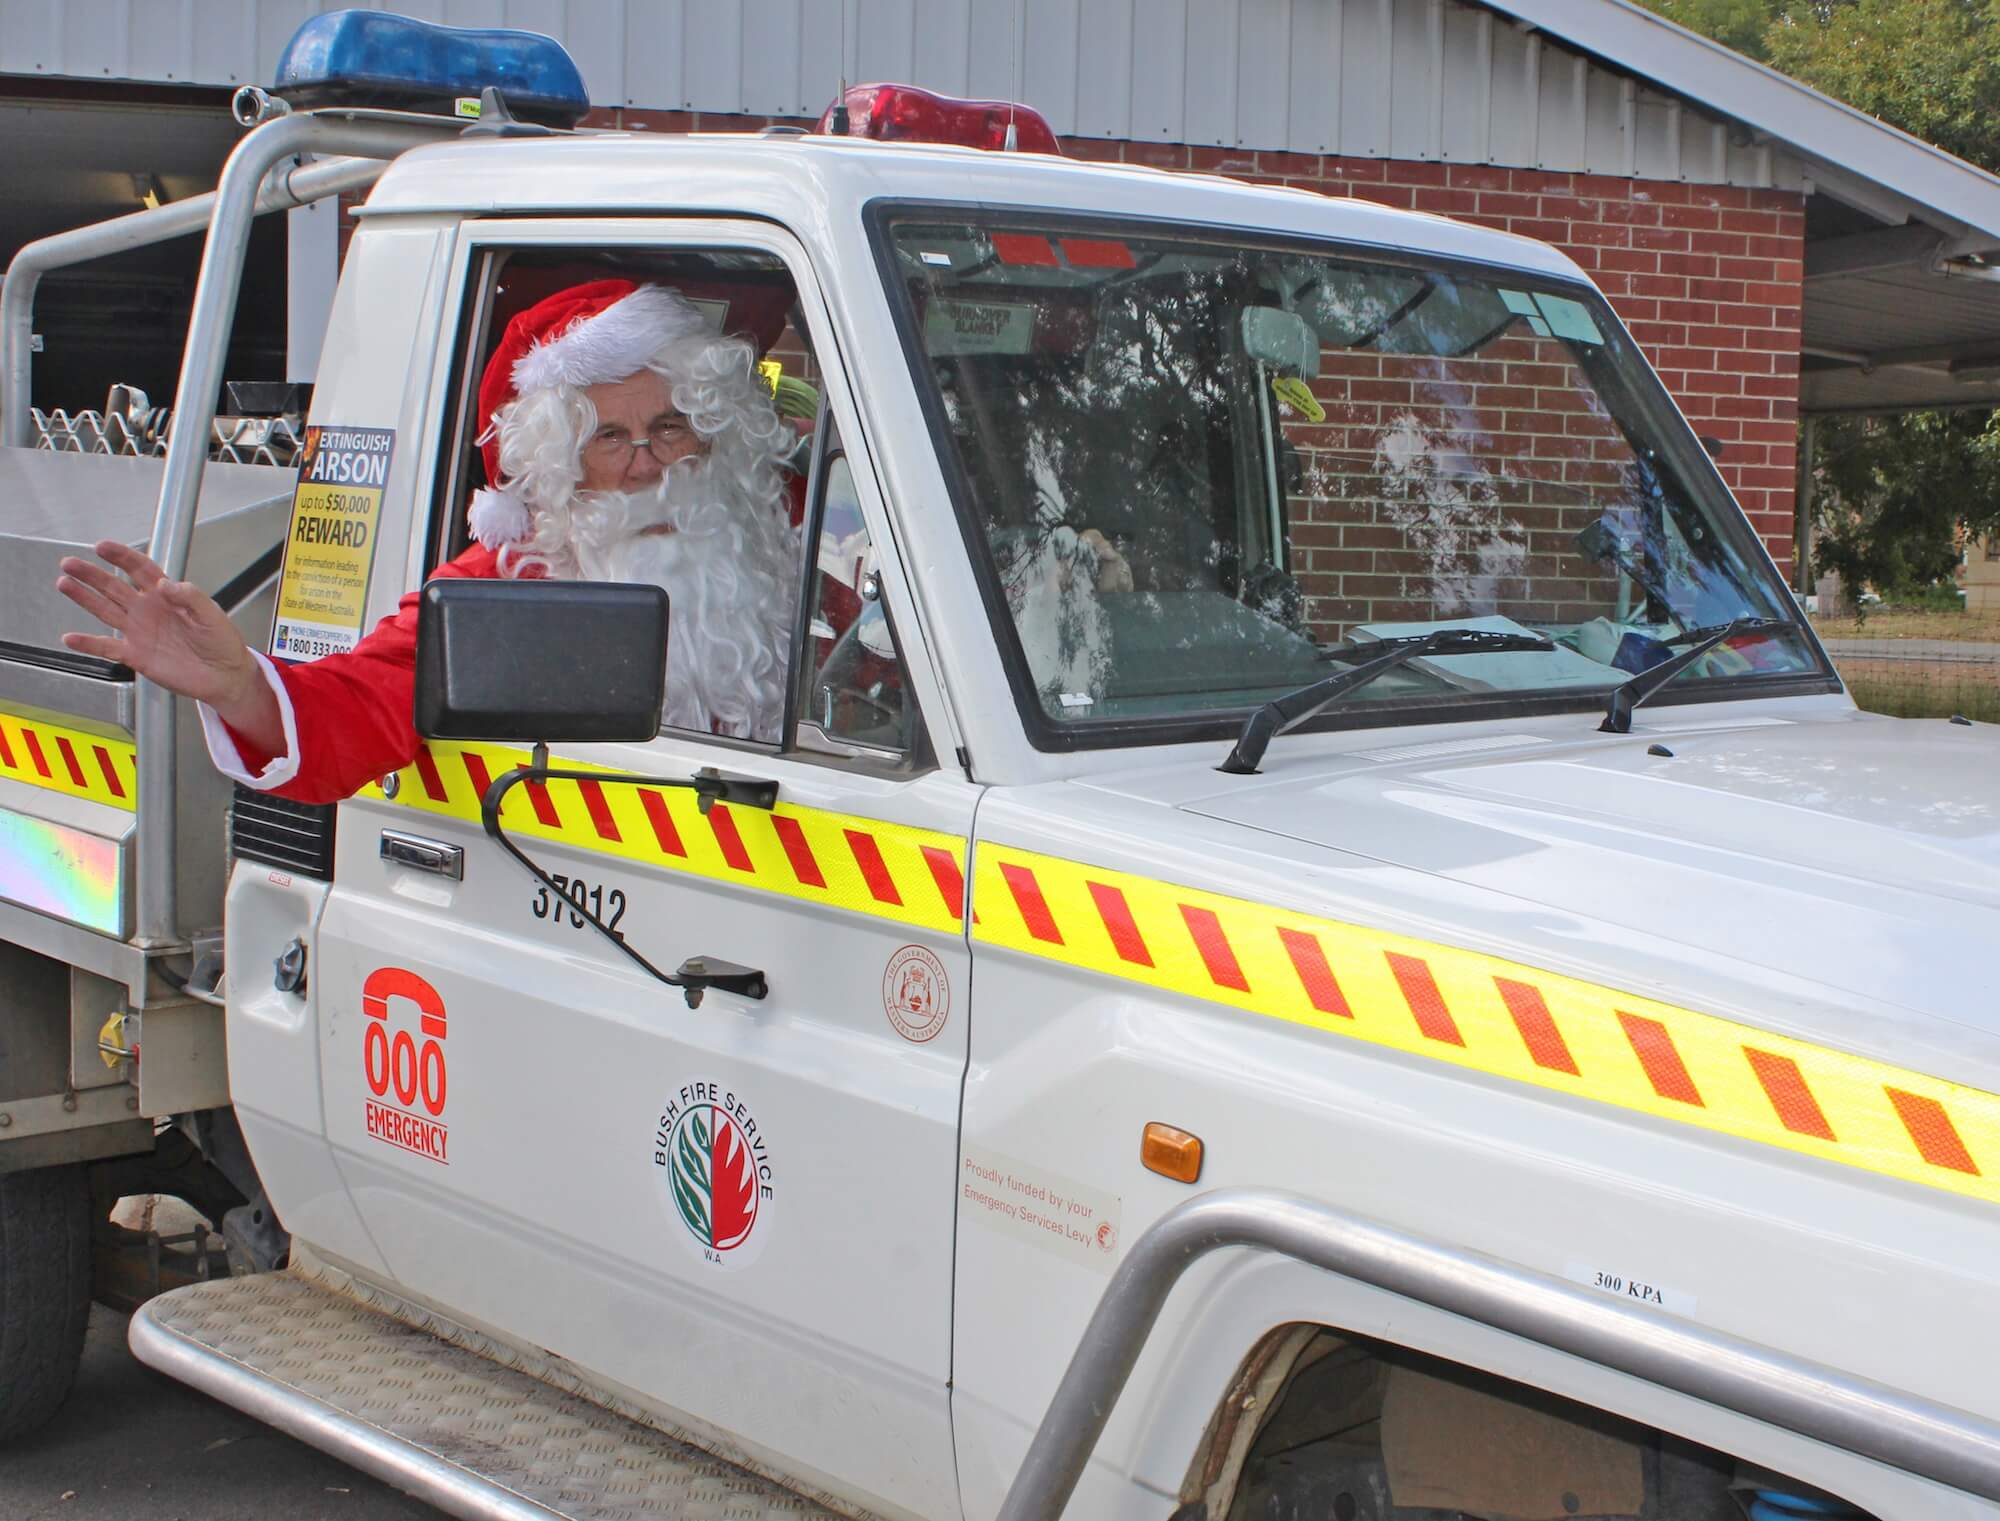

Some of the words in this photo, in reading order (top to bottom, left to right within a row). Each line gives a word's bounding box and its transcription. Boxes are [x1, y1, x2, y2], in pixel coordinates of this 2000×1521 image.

[319, 431, 391, 452] EXTINGUISH
[310, 451, 388, 485] ARSON
[301, 495, 313, 512] up
[314, 495, 325, 510] to
[325, 493, 371, 514] $50,000
[295, 516, 368, 548] REWARD
[292, 570, 301, 580] the
[301, 572, 331, 583] conviction
[342, 577, 361, 588] person
[302, 556, 336, 570] information
[335, 560, 359, 575] leading
[284, 597, 298, 608] State
[304, 600, 328, 612] Western
[288, 638, 310, 655] 1800
[311, 641, 330, 657] 333
[533, 872, 625, 941] 37012
[887, 962, 898, 979] THE
[897, 949, 942, 977] GOVERNMENT
[939, 978, 947, 993] OF
[886, 995, 911, 1036] WESTERN
[911, 1010, 946, 1039] AUSTRALIA
[364, 1021, 447, 1117] 000
[366, 1102, 449, 1160] EMERGENCY
[655, 1100, 680, 1167] BUSH
[680, 1082, 719, 1106] FIRE
[724, 1092, 773, 1201] SERVICE
[965, 1158, 1004, 1186] Proudly
[1007, 1175, 1046, 1201] funded
[1049, 1191, 1063, 1209] by
[1066, 1201, 1094, 1218] your
[964, 1184, 1018, 1219] Emergency
[1019, 1206, 1063, 1236] Services
[1066, 1223, 1093, 1248] Levy
[1594, 1272, 1622, 1291] 300
[1628, 1281, 1663, 1304] KPA
